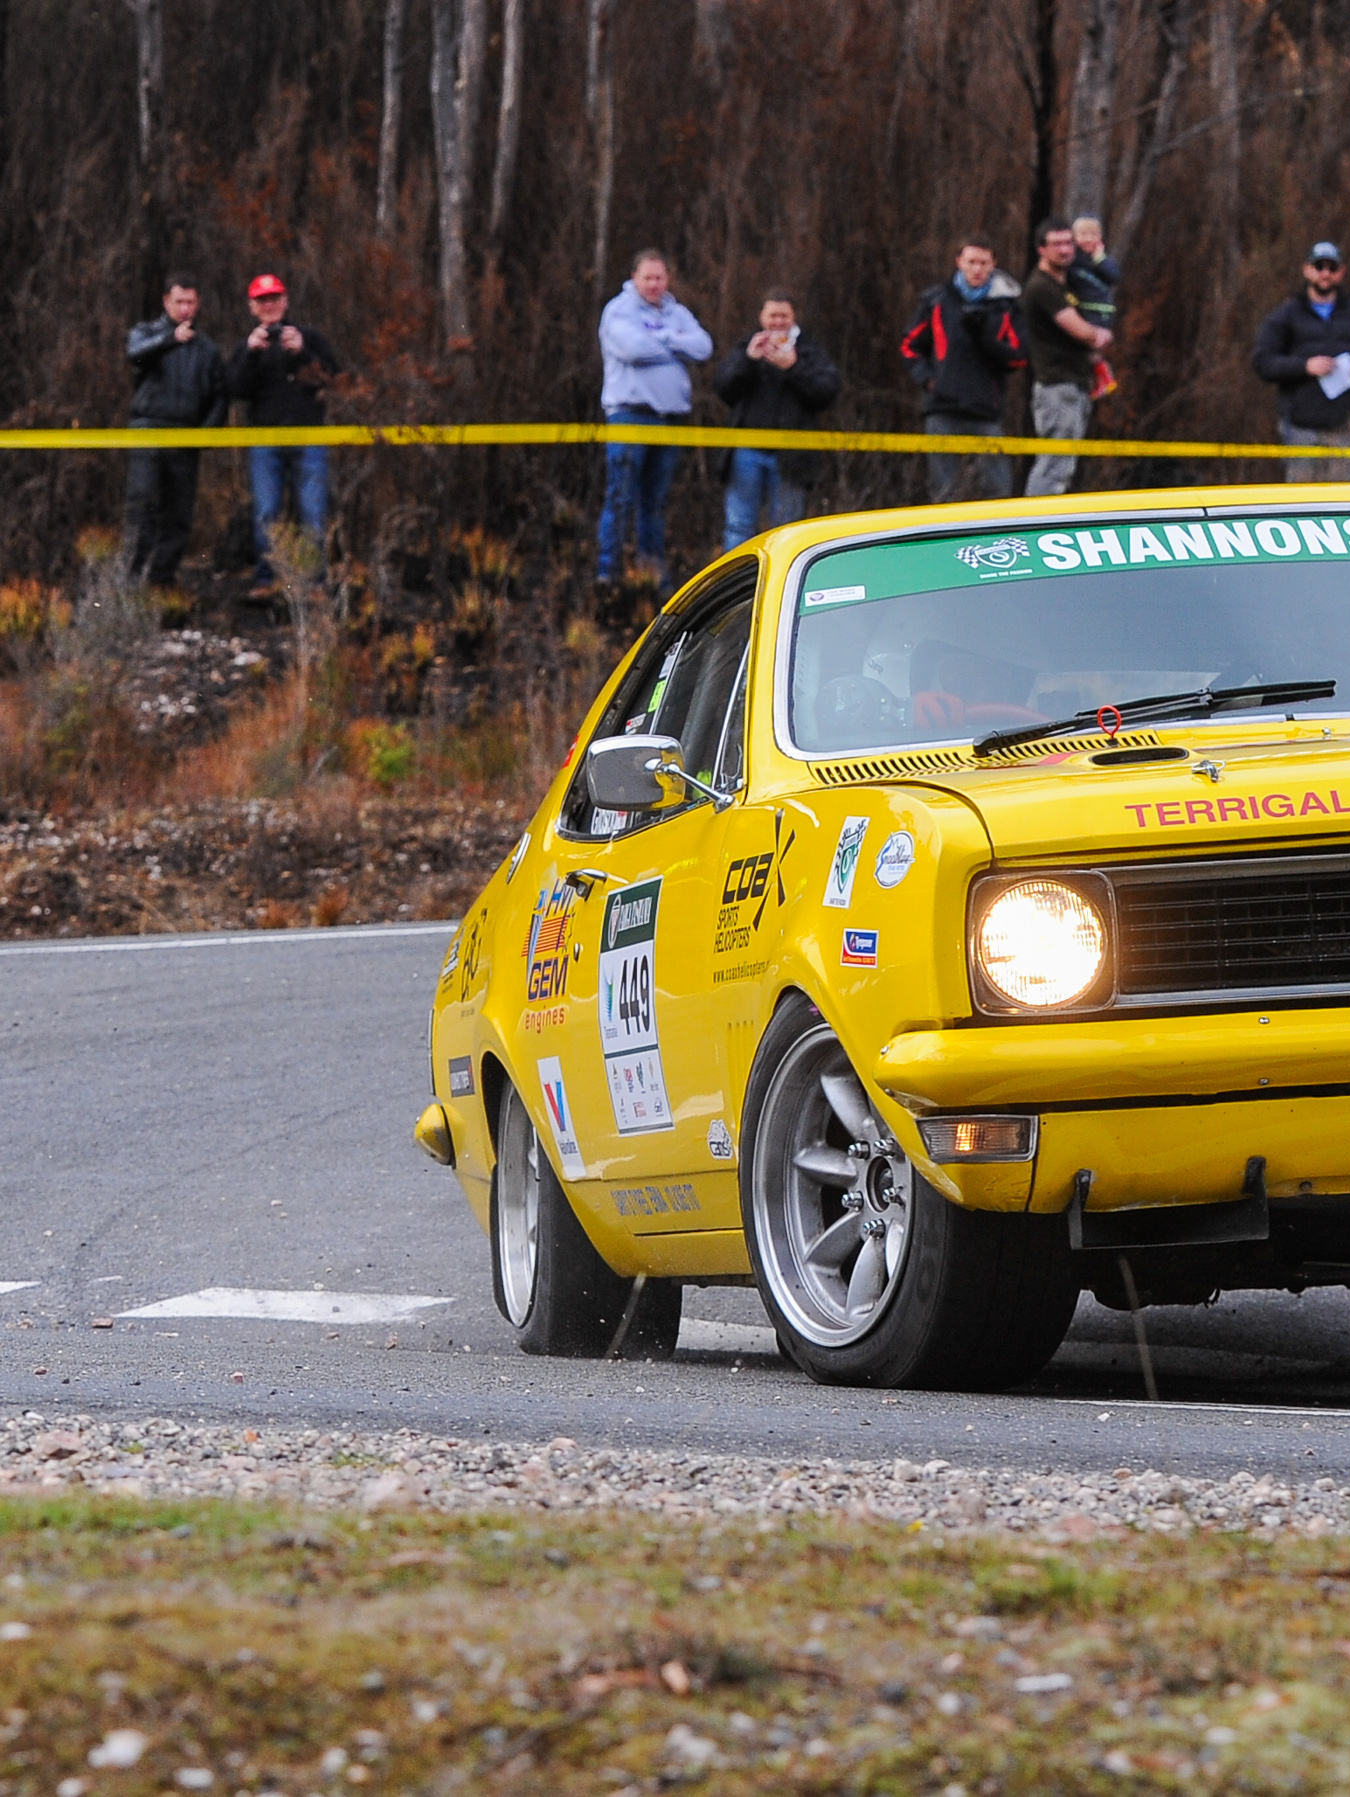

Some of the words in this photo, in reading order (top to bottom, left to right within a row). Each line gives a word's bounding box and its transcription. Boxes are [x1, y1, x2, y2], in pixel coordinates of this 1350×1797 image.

[528, 954, 570, 1003] GEM
[619, 955, 651, 1035] 449
[525, 1005, 565, 1034] engines
